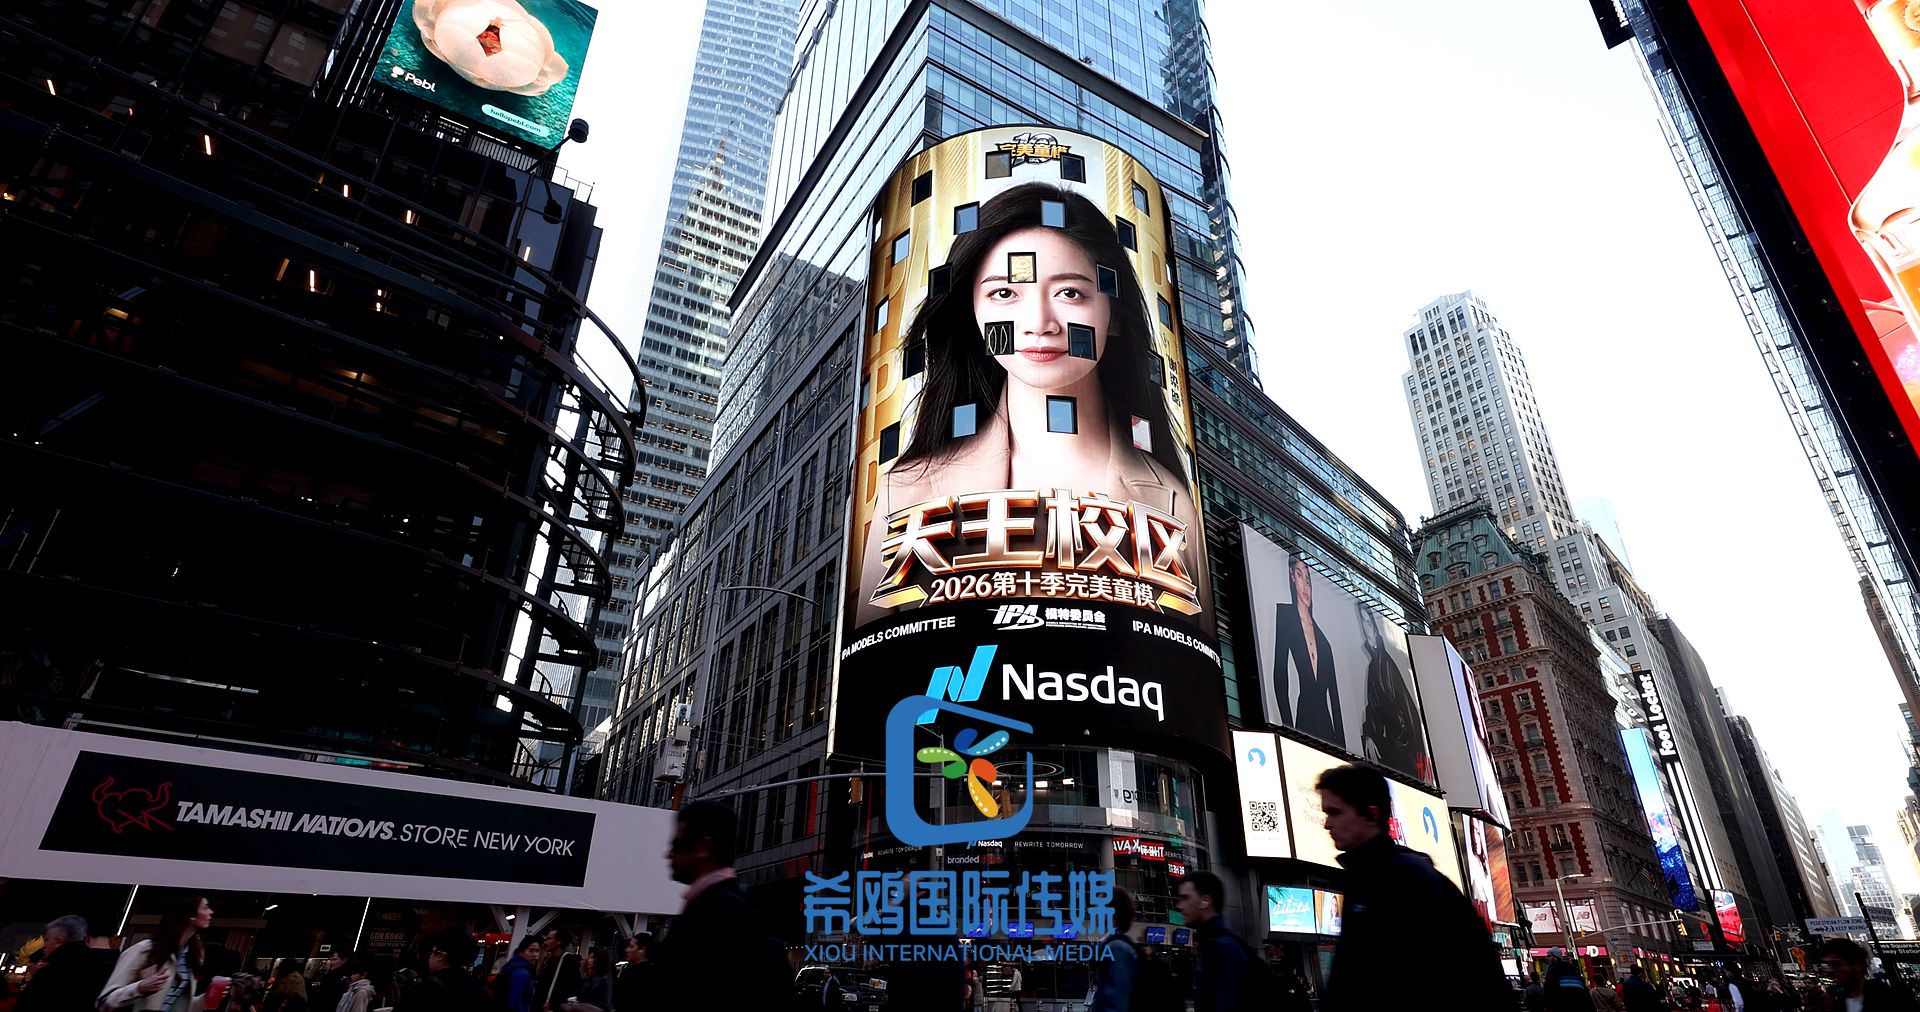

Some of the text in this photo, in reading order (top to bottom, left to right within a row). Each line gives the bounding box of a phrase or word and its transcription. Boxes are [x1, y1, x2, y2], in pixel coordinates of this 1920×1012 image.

[404, 72, 436, 93] Pebl
[490, 108, 542, 133] hellopebl.com
[877, 488, 1196, 592] 天王校区
[851, 631, 884, 654] MODELS
[885, 616, 956, 640] COMMITTEE
[1132, 620, 1152, 635] IPA
[1153, 624, 1193, 647] MODELS
[1002, 664, 1165, 722] Nasdaq
[1653, 723, 1677, 756] Foot
[176, 801, 576, 857] TAMASHII NATIONS STORE NEW YORK
[947, 855, 980, 864] branded
[977, 840, 1084, 849] Nasdaq REWRITE TOMORROW
